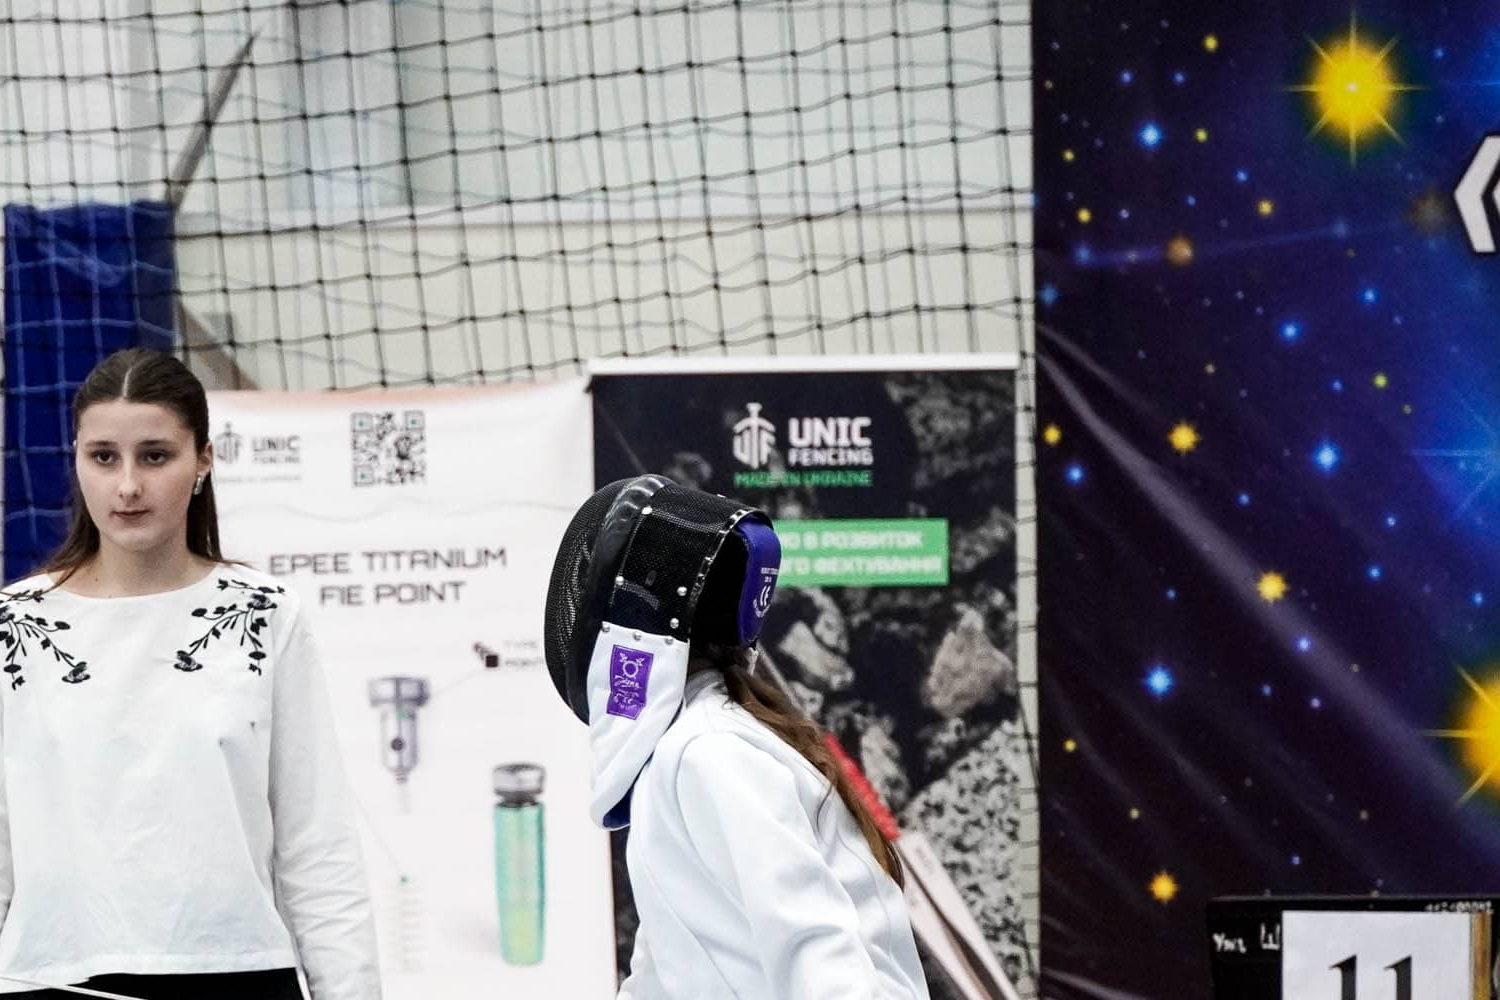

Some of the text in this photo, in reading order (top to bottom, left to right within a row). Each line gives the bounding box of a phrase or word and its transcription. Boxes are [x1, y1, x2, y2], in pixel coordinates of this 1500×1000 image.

[251, 434, 301, 453] UNIC
[788, 416, 872, 447] UNIC
[788, 447, 874, 466] FENCING
[269, 547, 507, 576] EPEE TITANIUM
[320, 581, 466, 606] FIE POINT
